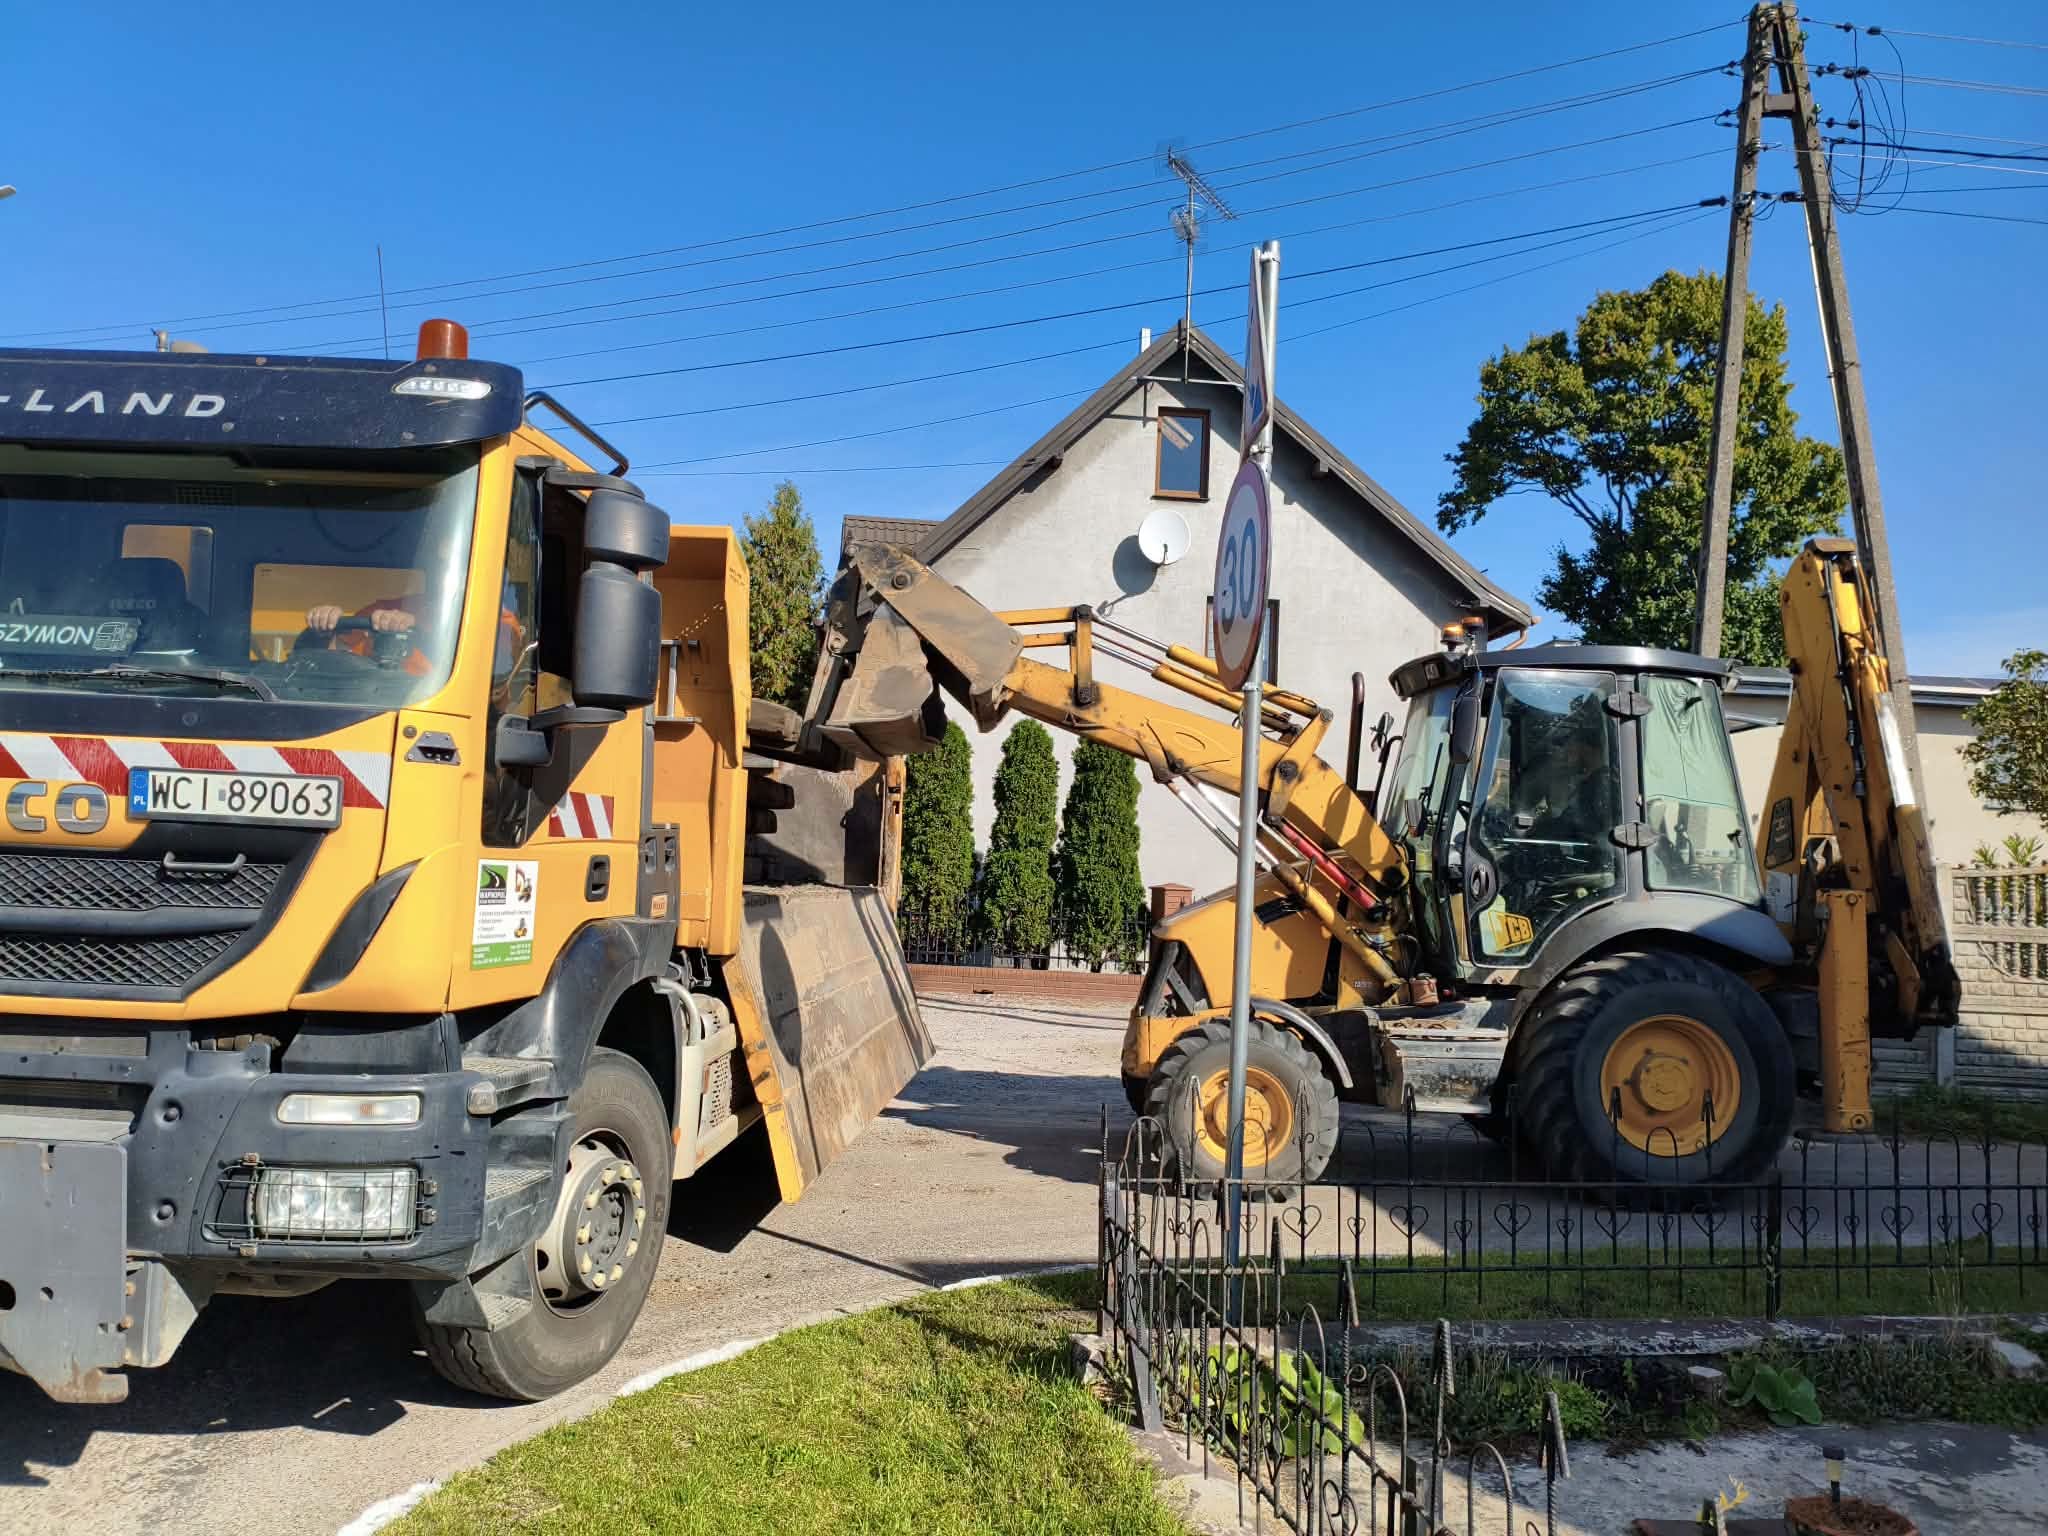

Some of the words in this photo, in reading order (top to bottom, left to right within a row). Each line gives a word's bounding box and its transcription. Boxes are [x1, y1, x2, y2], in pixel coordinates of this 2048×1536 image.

[1221, 517, 1257, 635] 30
[133, 796, 146, 806] PL
[151, 774, 209, 811] WCI
[227, 779, 333, 817] 89063
[1492, 911, 1533, 948] JCB
